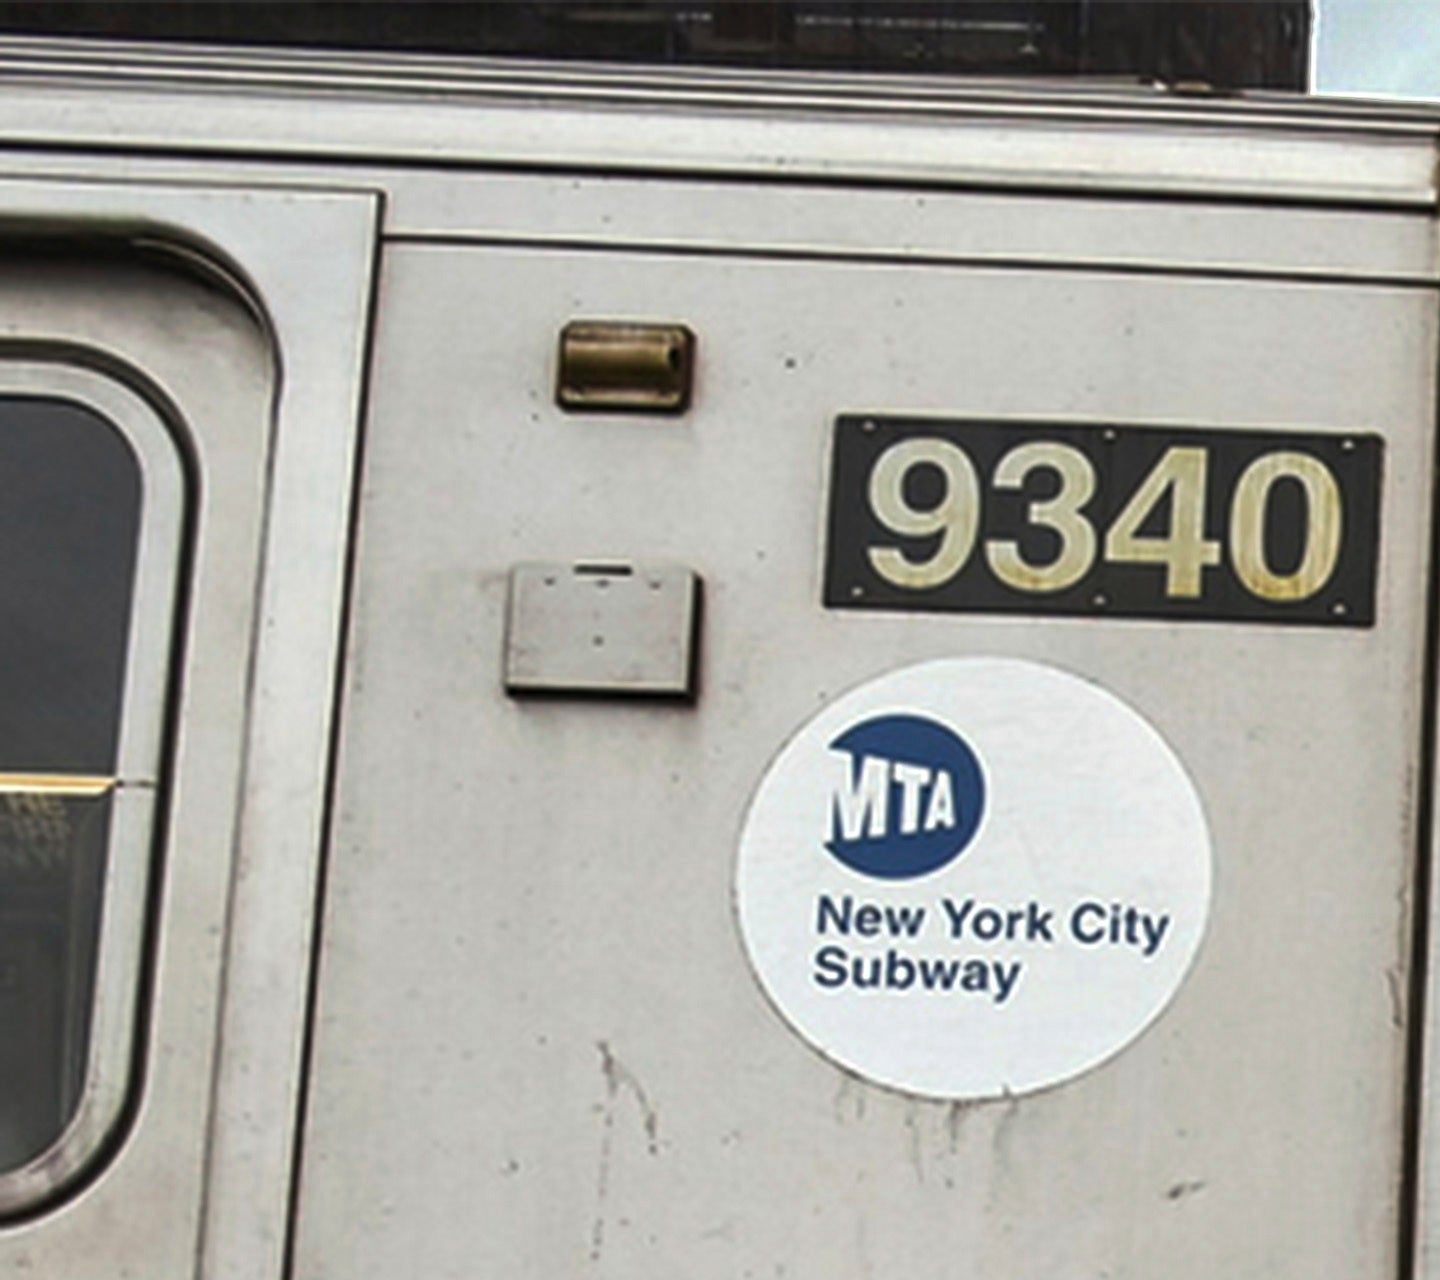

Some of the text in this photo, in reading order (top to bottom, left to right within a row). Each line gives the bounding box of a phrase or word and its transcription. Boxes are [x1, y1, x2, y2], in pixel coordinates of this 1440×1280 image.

[864, 437, 1343, 604] 9340
[824, 749, 958, 845] MTA
[816, 895, 1170, 956] New York City
[813, 946, 1021, 1003] Subway
